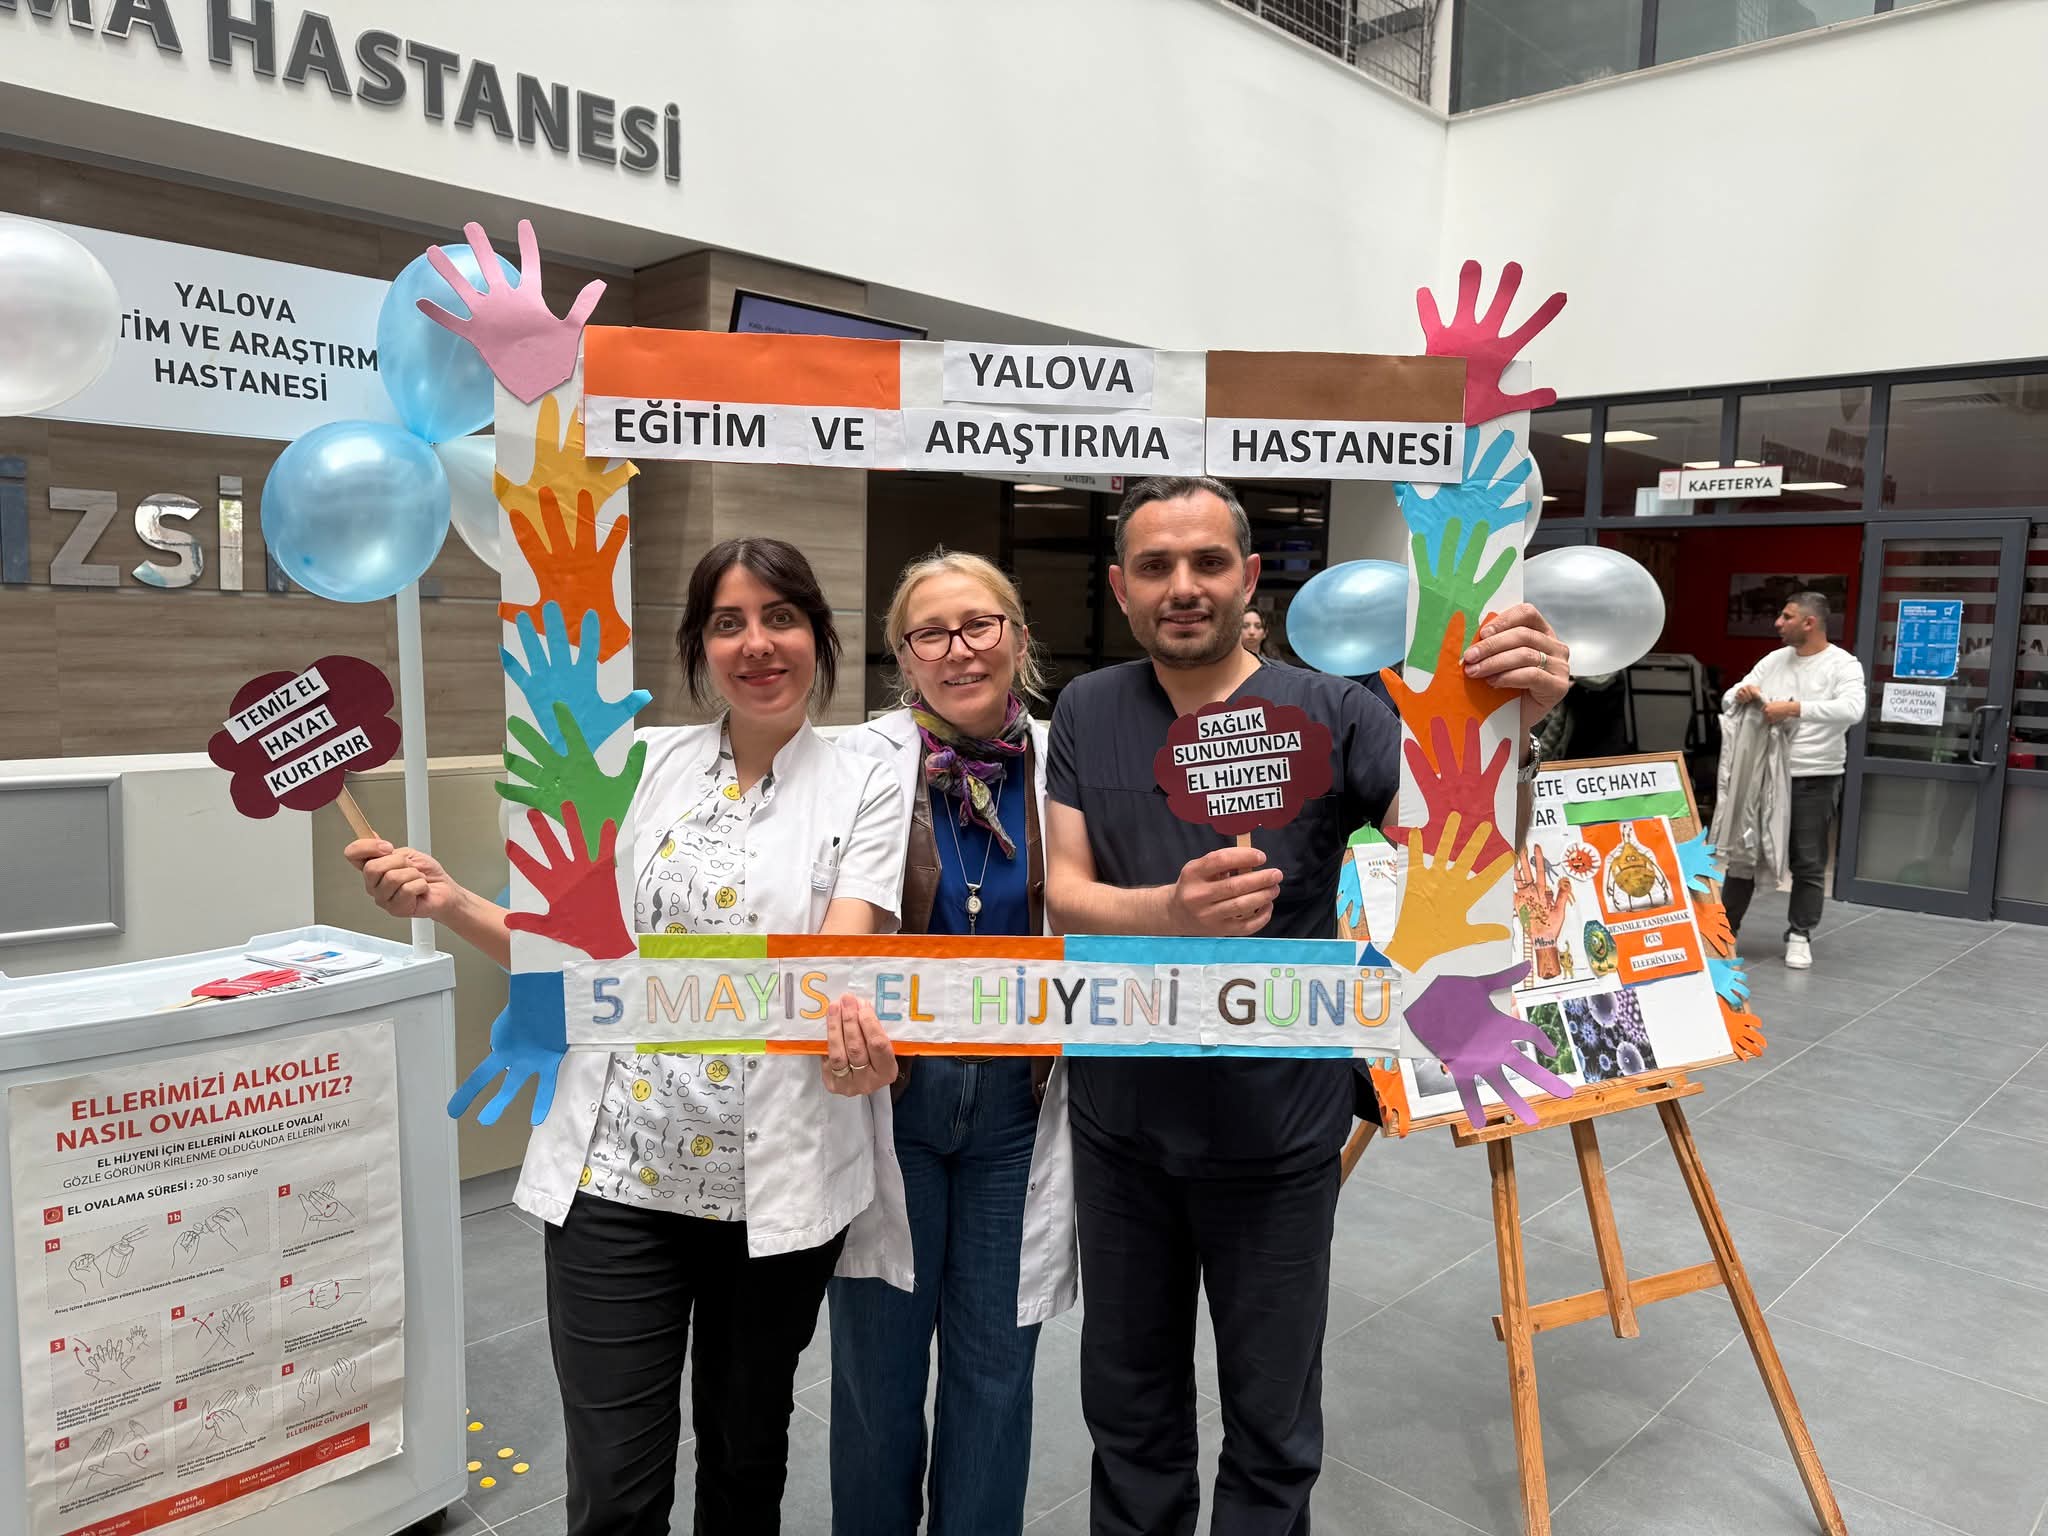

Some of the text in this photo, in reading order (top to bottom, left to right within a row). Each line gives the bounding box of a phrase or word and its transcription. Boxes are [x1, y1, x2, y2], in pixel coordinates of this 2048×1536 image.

[207, 0, 680, 181] HASTANESİ
[174, 282, 296, 324] YALOVA
[180, 322, 220, 351] VE
[155, 358, 328, 402] HASTANESİ
[969, 353, 1134, 393] YALOVA
[614, 400, 1453, 466] EĞİTİM VE ARAŞTIRMA HASTANESİ
[1688, 477, 1773, 493] KAFETERYA
[235, 676, 320, 732] TEMİZ EL
[1200, 713, 1264, 738] SAĞLIK
[264, 709, 332, 756] HAYAT
[1175, 732, 1300, 764] SUNUMUNDA
[270, 734, 369, 792] KURTARIR
[1188, 758, 1288, 792] EL HİJYENİ
[1576, 775, 1608, 797] GEÇ
[1608, 771, 1657, 792] HAYAT
[1208, 788, 1282, 816] HİZMETİ
[592, 965, 1391, 1028] 5 MAYIS EL HİJYENİ GÜNÜ
[72, 1053, 340, 1121] ELLERİMİZİ ALKOLLE
[56, 1075, 353, 1152] NASIL OVALAMALIYIZ?
[63, 1119, 351, 1189] GÖZLE GÖRÜNÜR KİRLENME OLDUĞUNDA ELLERİNİ YIKA!
[97, 1113, 323, 1168] EL HİJYENİ İÇİN ELLERİNİ ALKOLLE OVALA!
[67, 1205, 82, 1216] EL
[84, 1191, 145, 1212] OVALAMA
[147, 1180, 188, 1199] SÜRESİ
[196, 1173, 225, 1188] 20-30
[227, 1168, 259, 1182] saniye
[168, 1211, 181, 1223] 1b
[47, 1240, 58, 1251] 1a
[175, 1495, 198, 1507] HASTA
